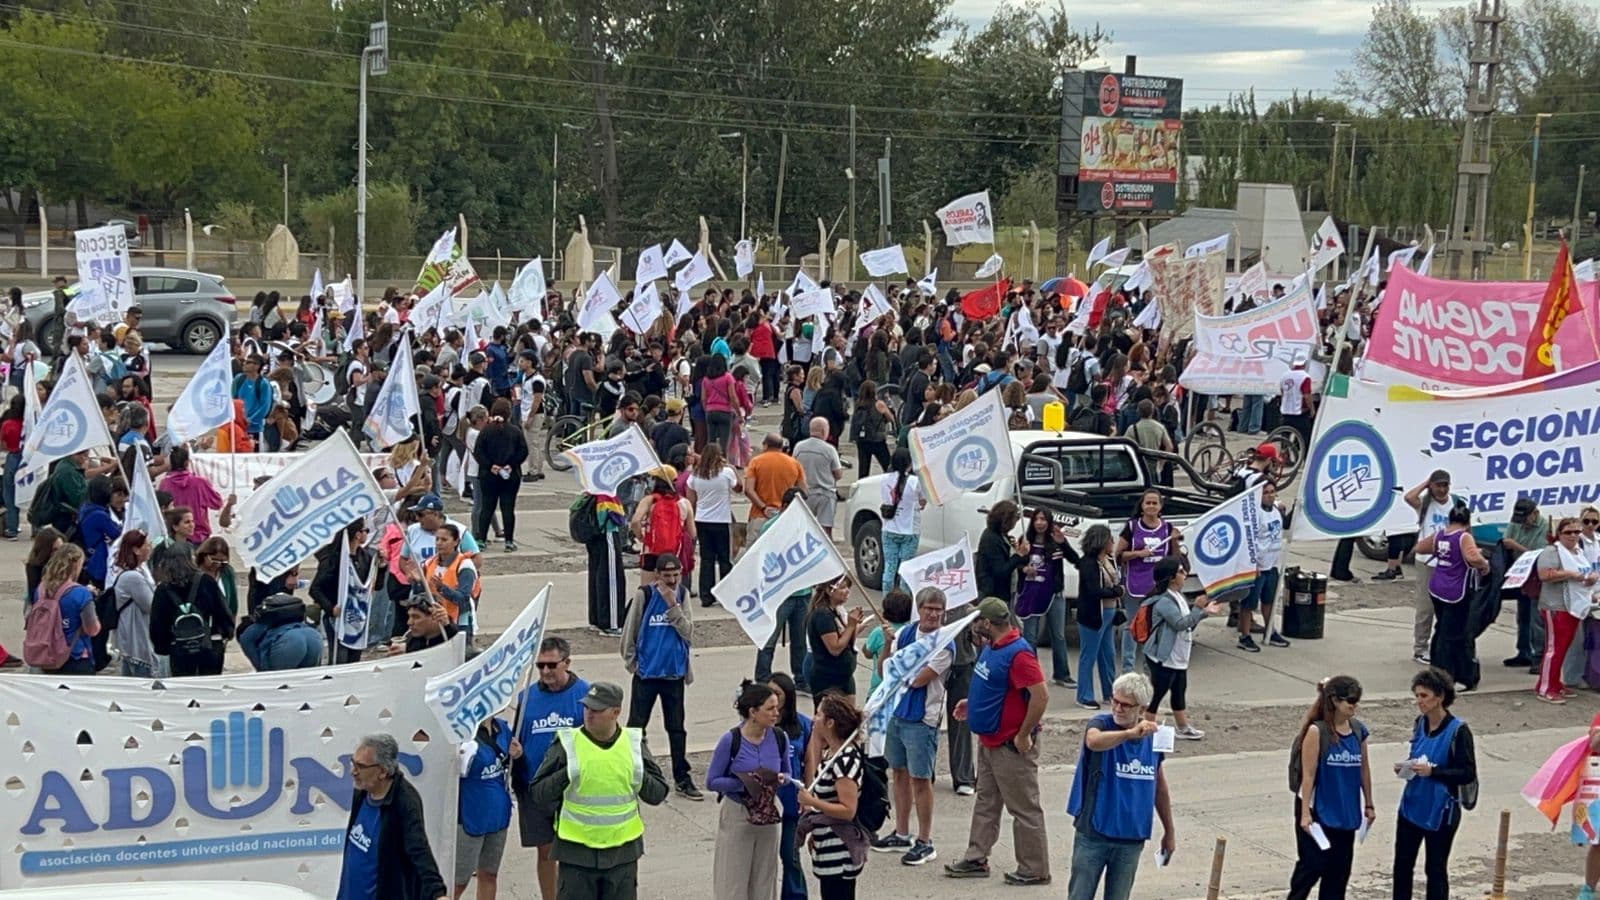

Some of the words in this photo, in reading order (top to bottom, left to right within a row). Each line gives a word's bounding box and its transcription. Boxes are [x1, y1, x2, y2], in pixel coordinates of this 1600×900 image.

[1486, 446, 1584, 481] ROCA
[1053, 512, 1077, 526] ILUX
[532, 712, 575, 729] ADUNC
[39, 852, 111, 867] asociación
[116, 848, 178, 862] docentes
[182, 839, 259, 857] universidad
[263, 834, 317, 849] nacional
[321, 833, 341, 846] del
